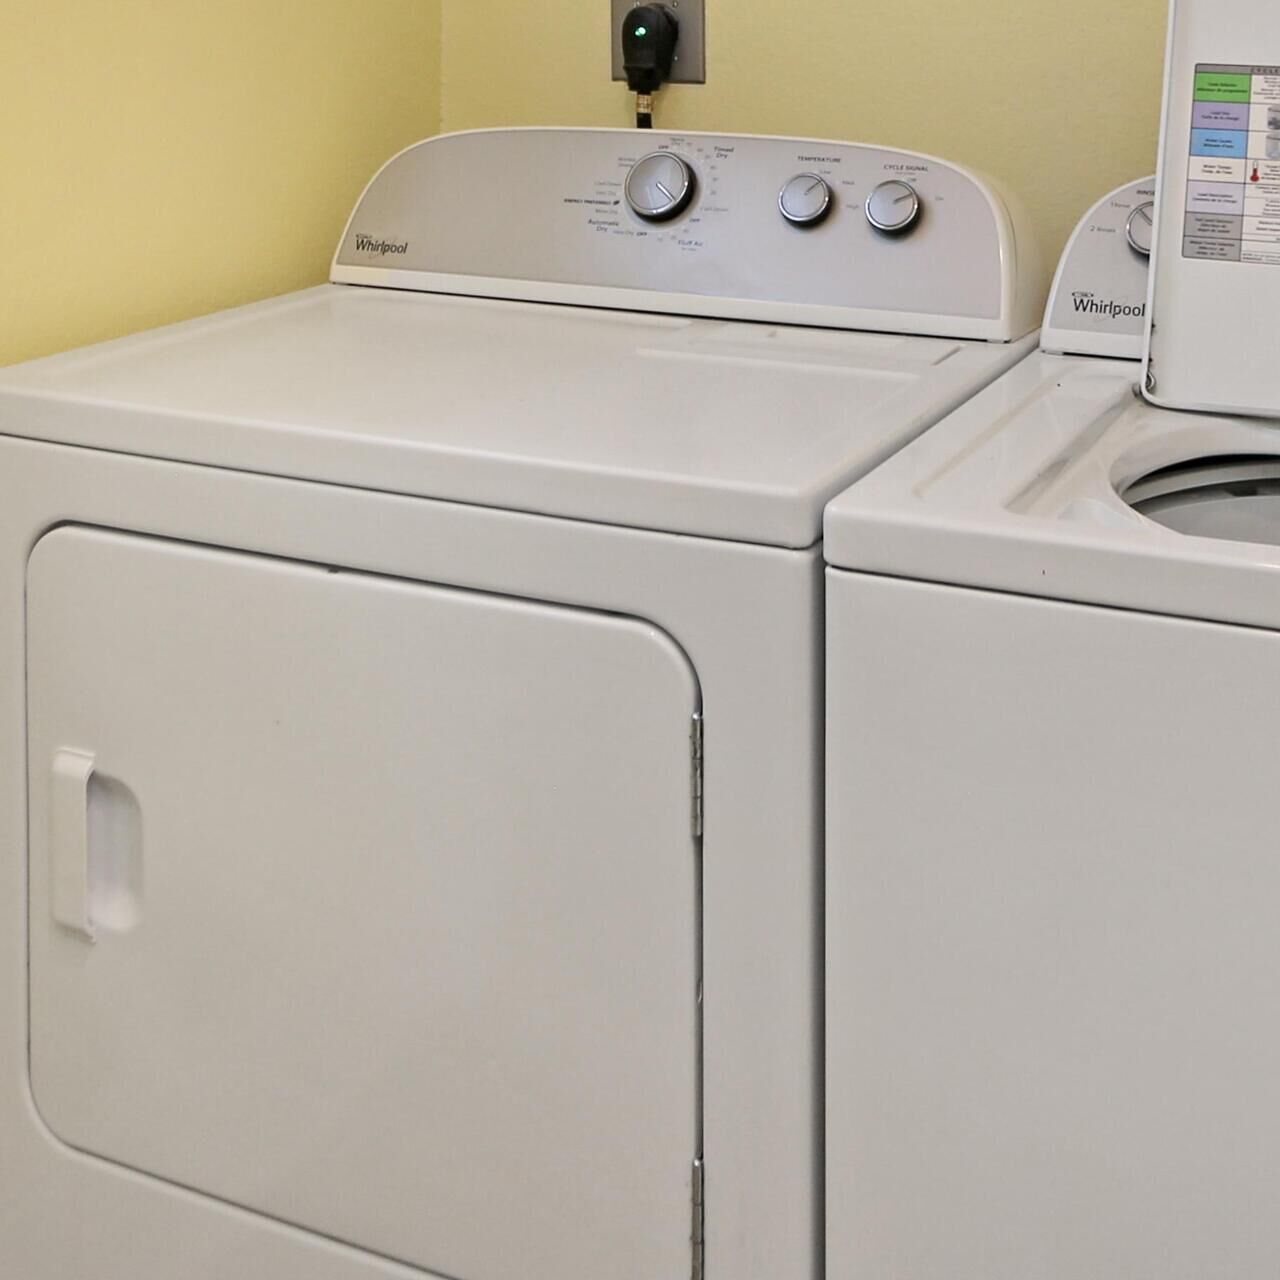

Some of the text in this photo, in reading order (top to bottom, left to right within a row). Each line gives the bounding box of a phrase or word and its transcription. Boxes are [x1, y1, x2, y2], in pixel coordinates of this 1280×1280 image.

[797, 155, 842, 163] TEMPERATURE
[356, 238, 409, 256] Whirlpool
[1073, 297, 1146, 319] Whirlpool
